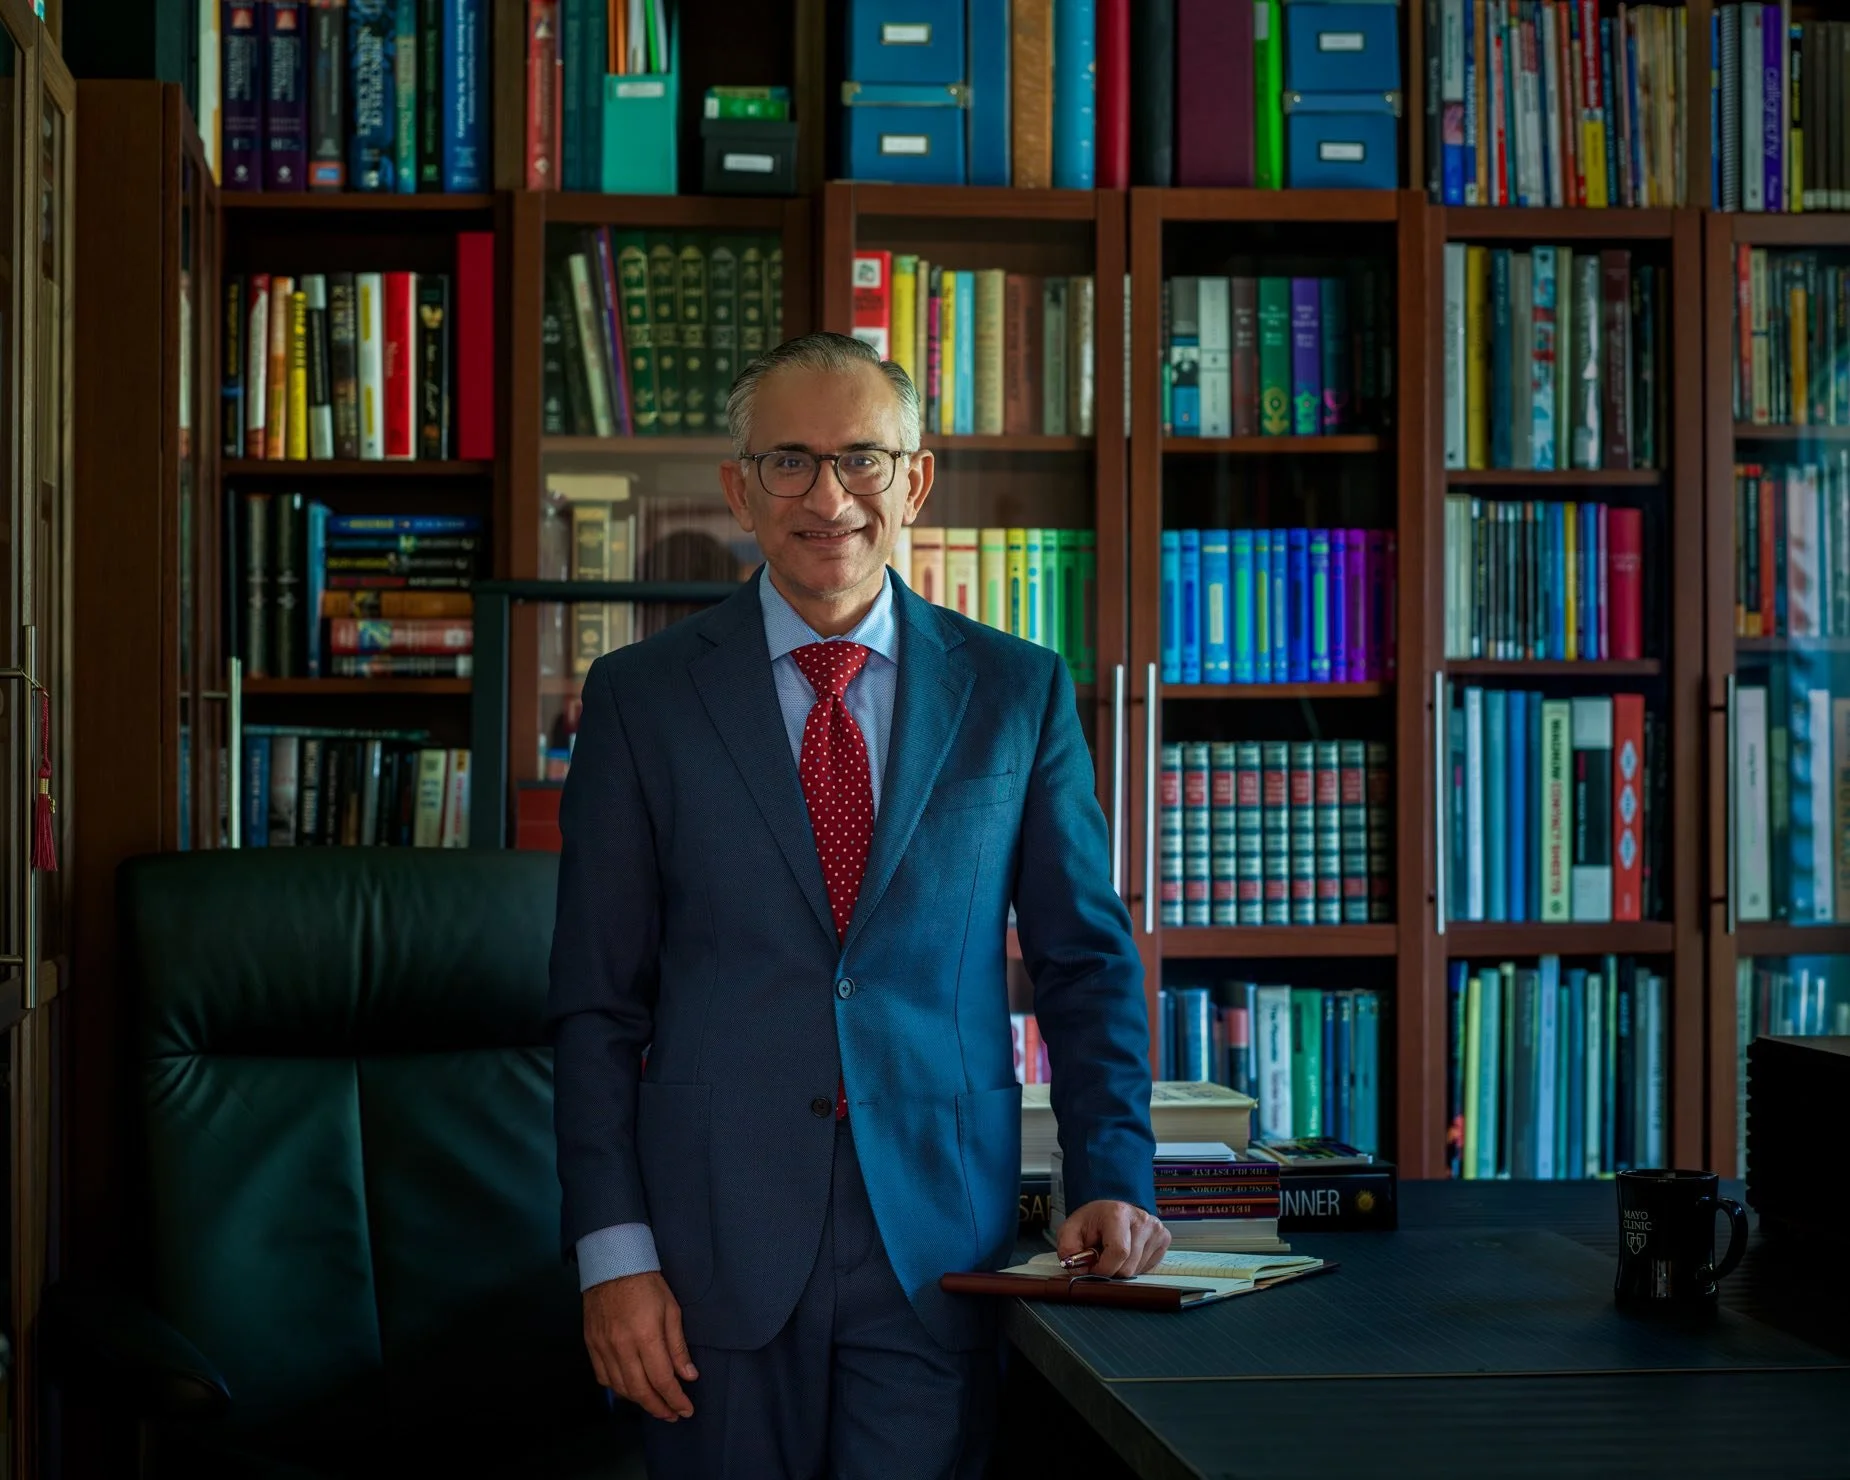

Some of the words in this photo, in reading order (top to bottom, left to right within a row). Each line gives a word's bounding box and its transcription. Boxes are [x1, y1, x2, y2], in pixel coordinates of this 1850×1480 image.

[1191, 1168, 1211, 1177] EYE
[1248, 1167, 1269, 1176] THE
[1248, 1185, 1273, 1193] SONG
[1197, 1204, 1252, 1214] BELOVED
[1624, 1209, 1649, 1221] MAYO
[1622, 1219, 1653, 1232] CLINIC
